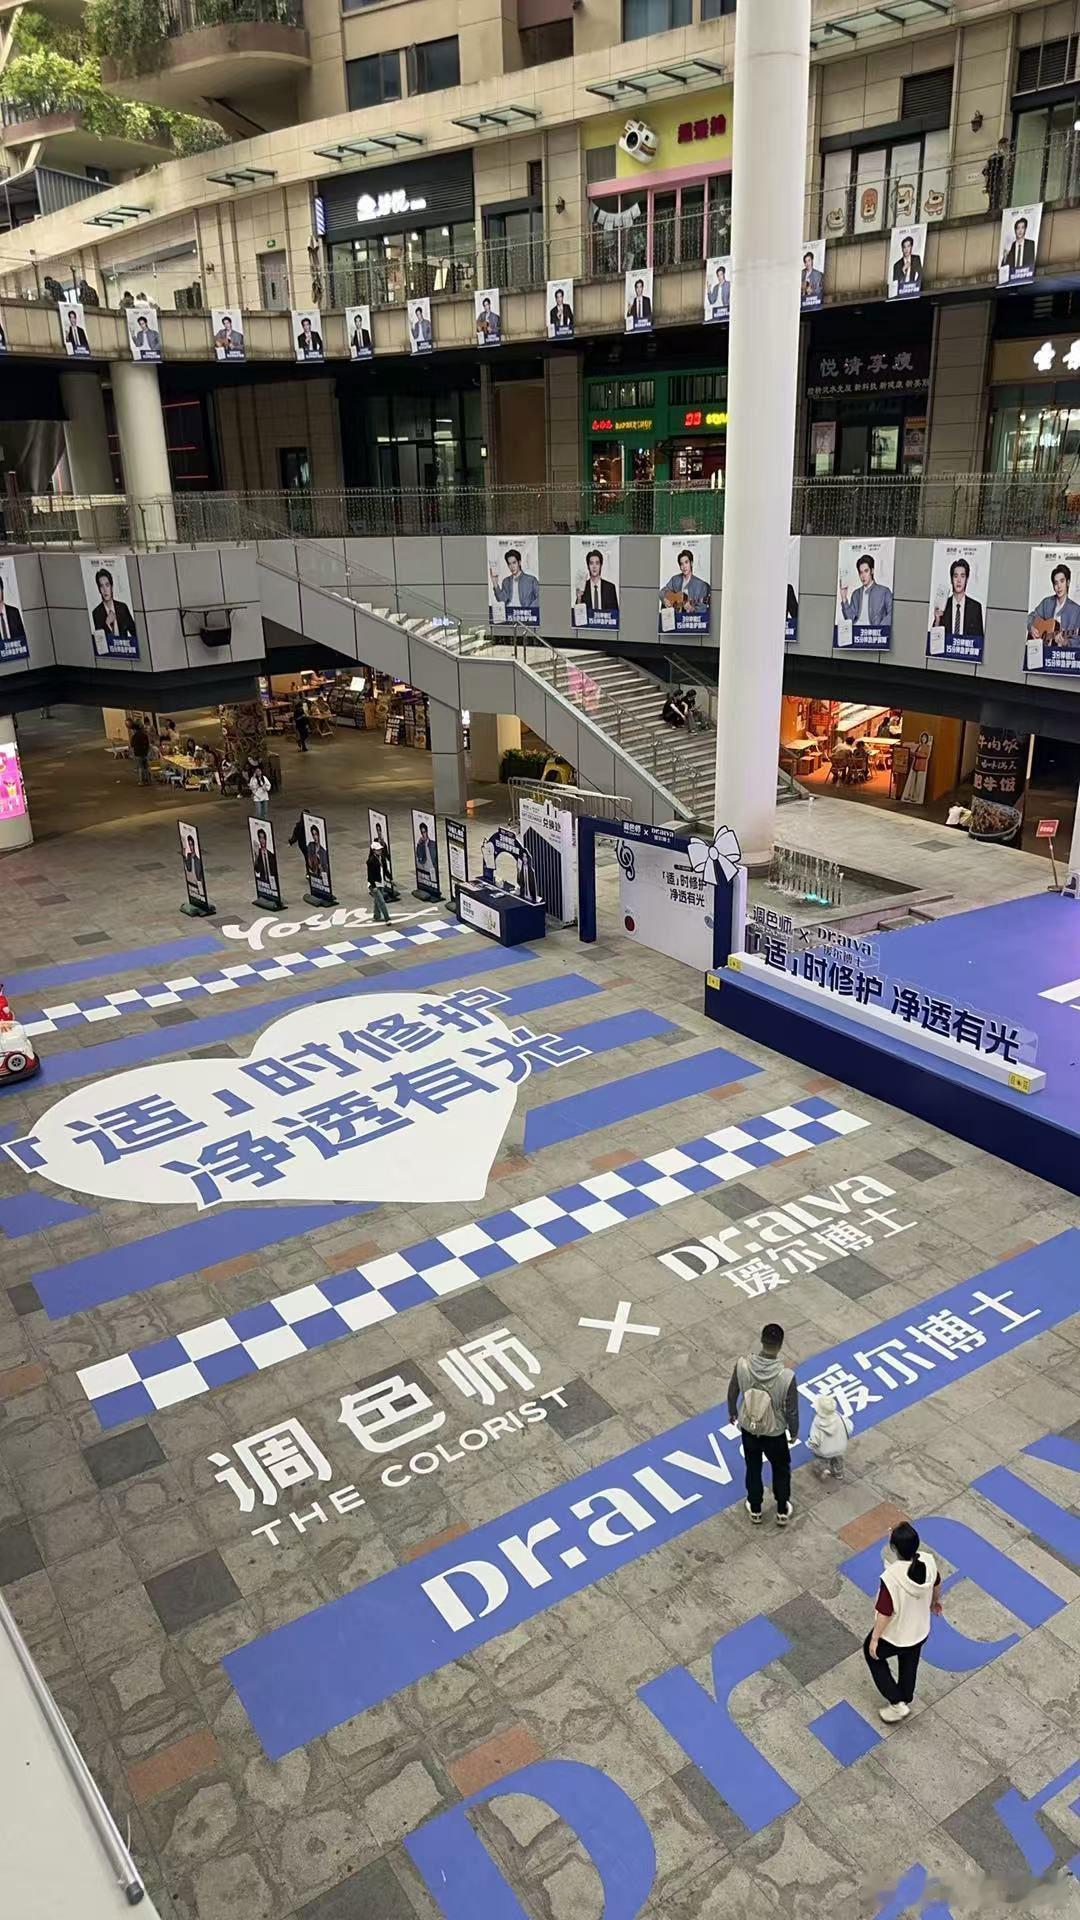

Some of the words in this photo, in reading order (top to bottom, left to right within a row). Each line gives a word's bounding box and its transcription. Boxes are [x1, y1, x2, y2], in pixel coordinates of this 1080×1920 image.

[669, 888, 705, 907] 净透有光
[752, 904, 793, 935] 调色师
[752, 932, 884, 1003] 「适」时修护
[890, 984, 1020, 1065] 净透有光
[6, 987, 509, 1171] 「适」时修护
[160, 1028, 590, 1206] 净透有光
[719, 1207, 919, 1299] 瑷尔博士
[214, 1326, 541, 1513] 调色师
[796, 1289, 1043, 1418] 瑷尔博士
[249, 1484, 367, 1546] THE
[381, 1385, 570, 1489] COLORIST
